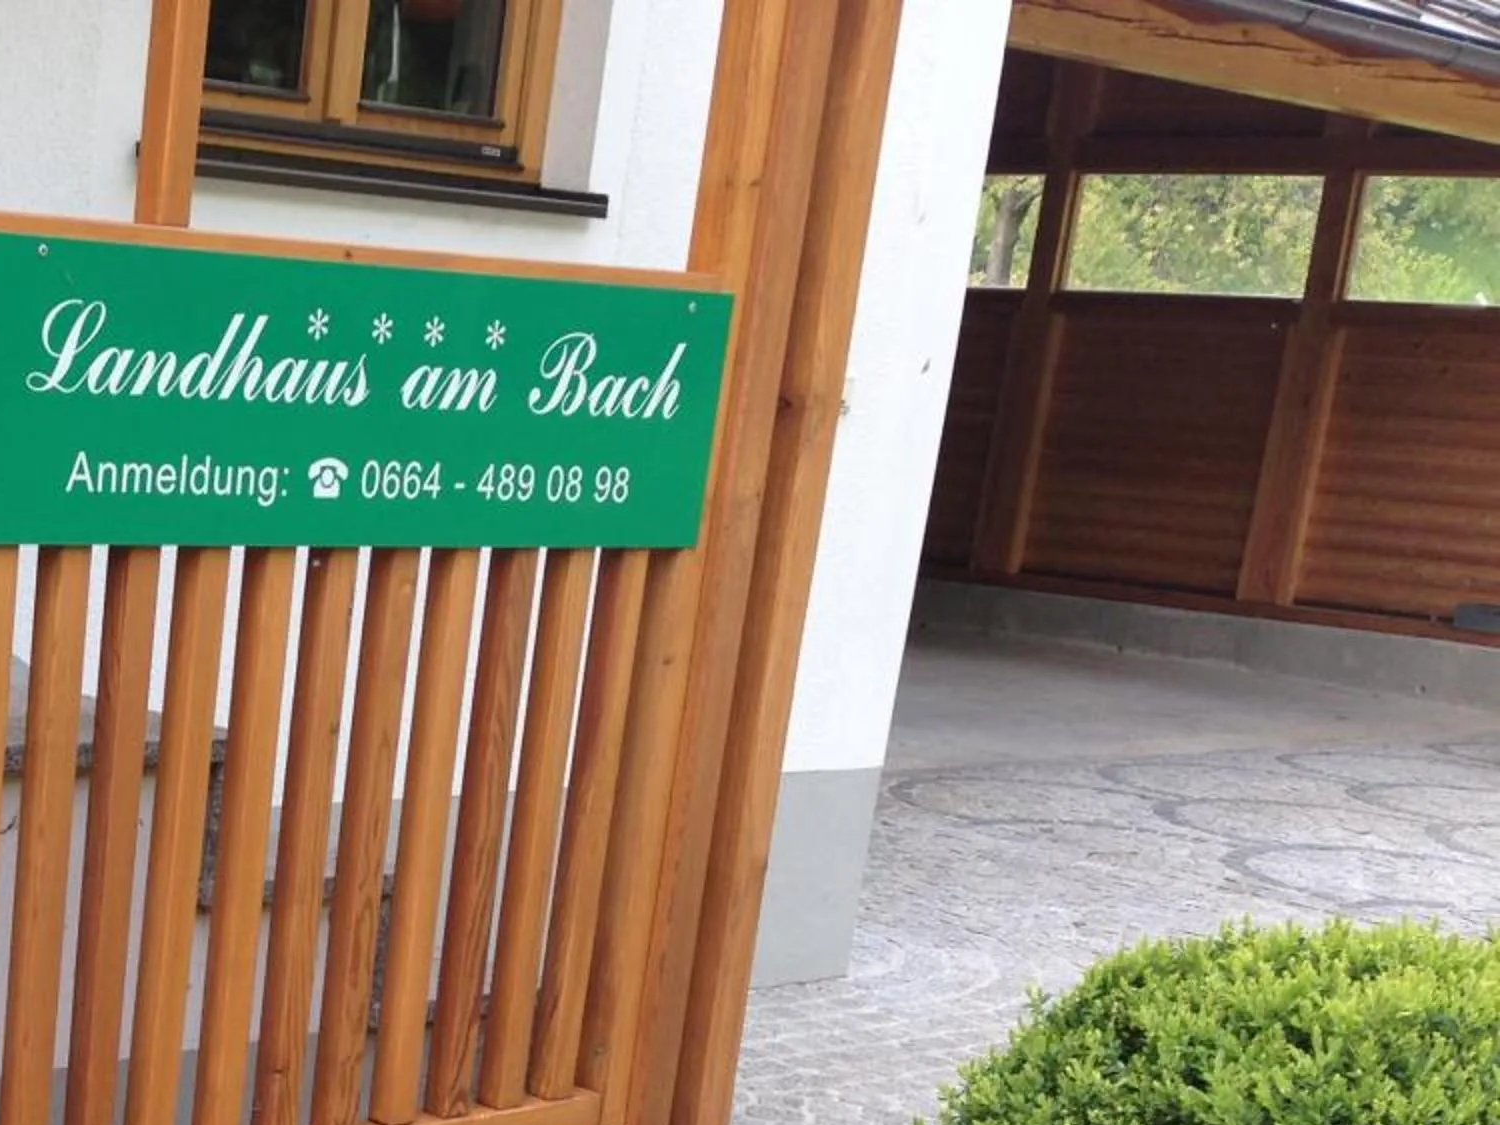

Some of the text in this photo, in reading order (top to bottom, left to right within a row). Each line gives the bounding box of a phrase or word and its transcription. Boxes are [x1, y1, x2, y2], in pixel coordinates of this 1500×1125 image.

[25, 299, 687, 420] Landhaus am Bach
[66, 451, 291, 507] Anmeldung:
[360, 460, 442, 499] 0664
[476, 463, 536, 502] 489
[546, 464, 585, 503] 08
[593, 466, 631, 504] 98
